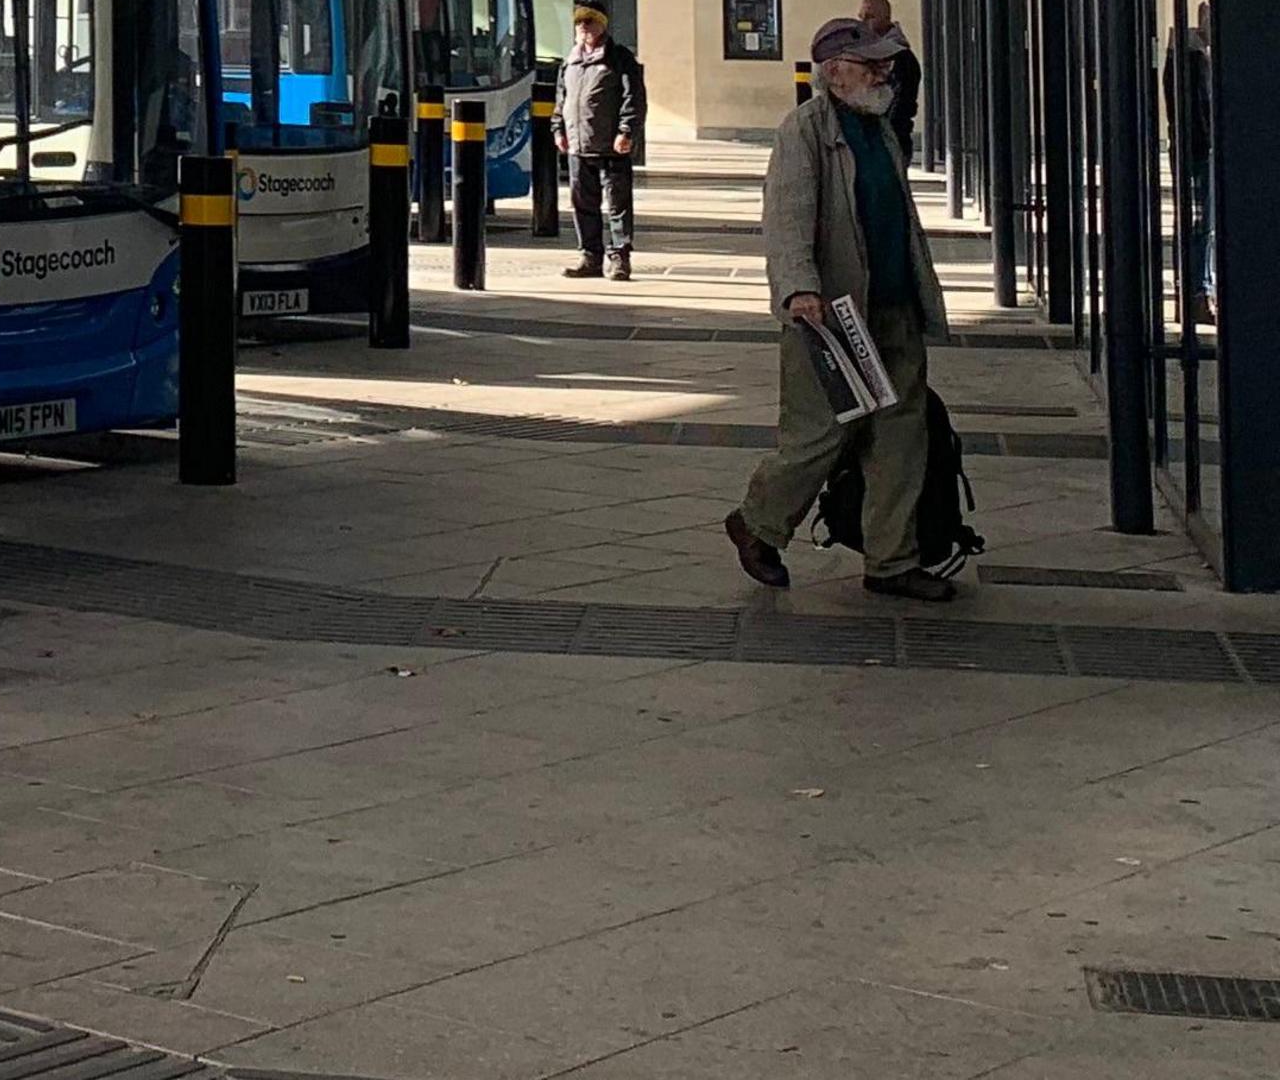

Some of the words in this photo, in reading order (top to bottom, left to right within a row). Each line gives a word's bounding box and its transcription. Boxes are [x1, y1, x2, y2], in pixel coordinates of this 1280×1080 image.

[258, 171, 335, 195] Stagecoach
[1, 238, 116, 280] Stagecoach
[278, 291, 301, 311] FLA
[835, 300, 870, 360] METRO
[30, 401, 65, 431] FPN
